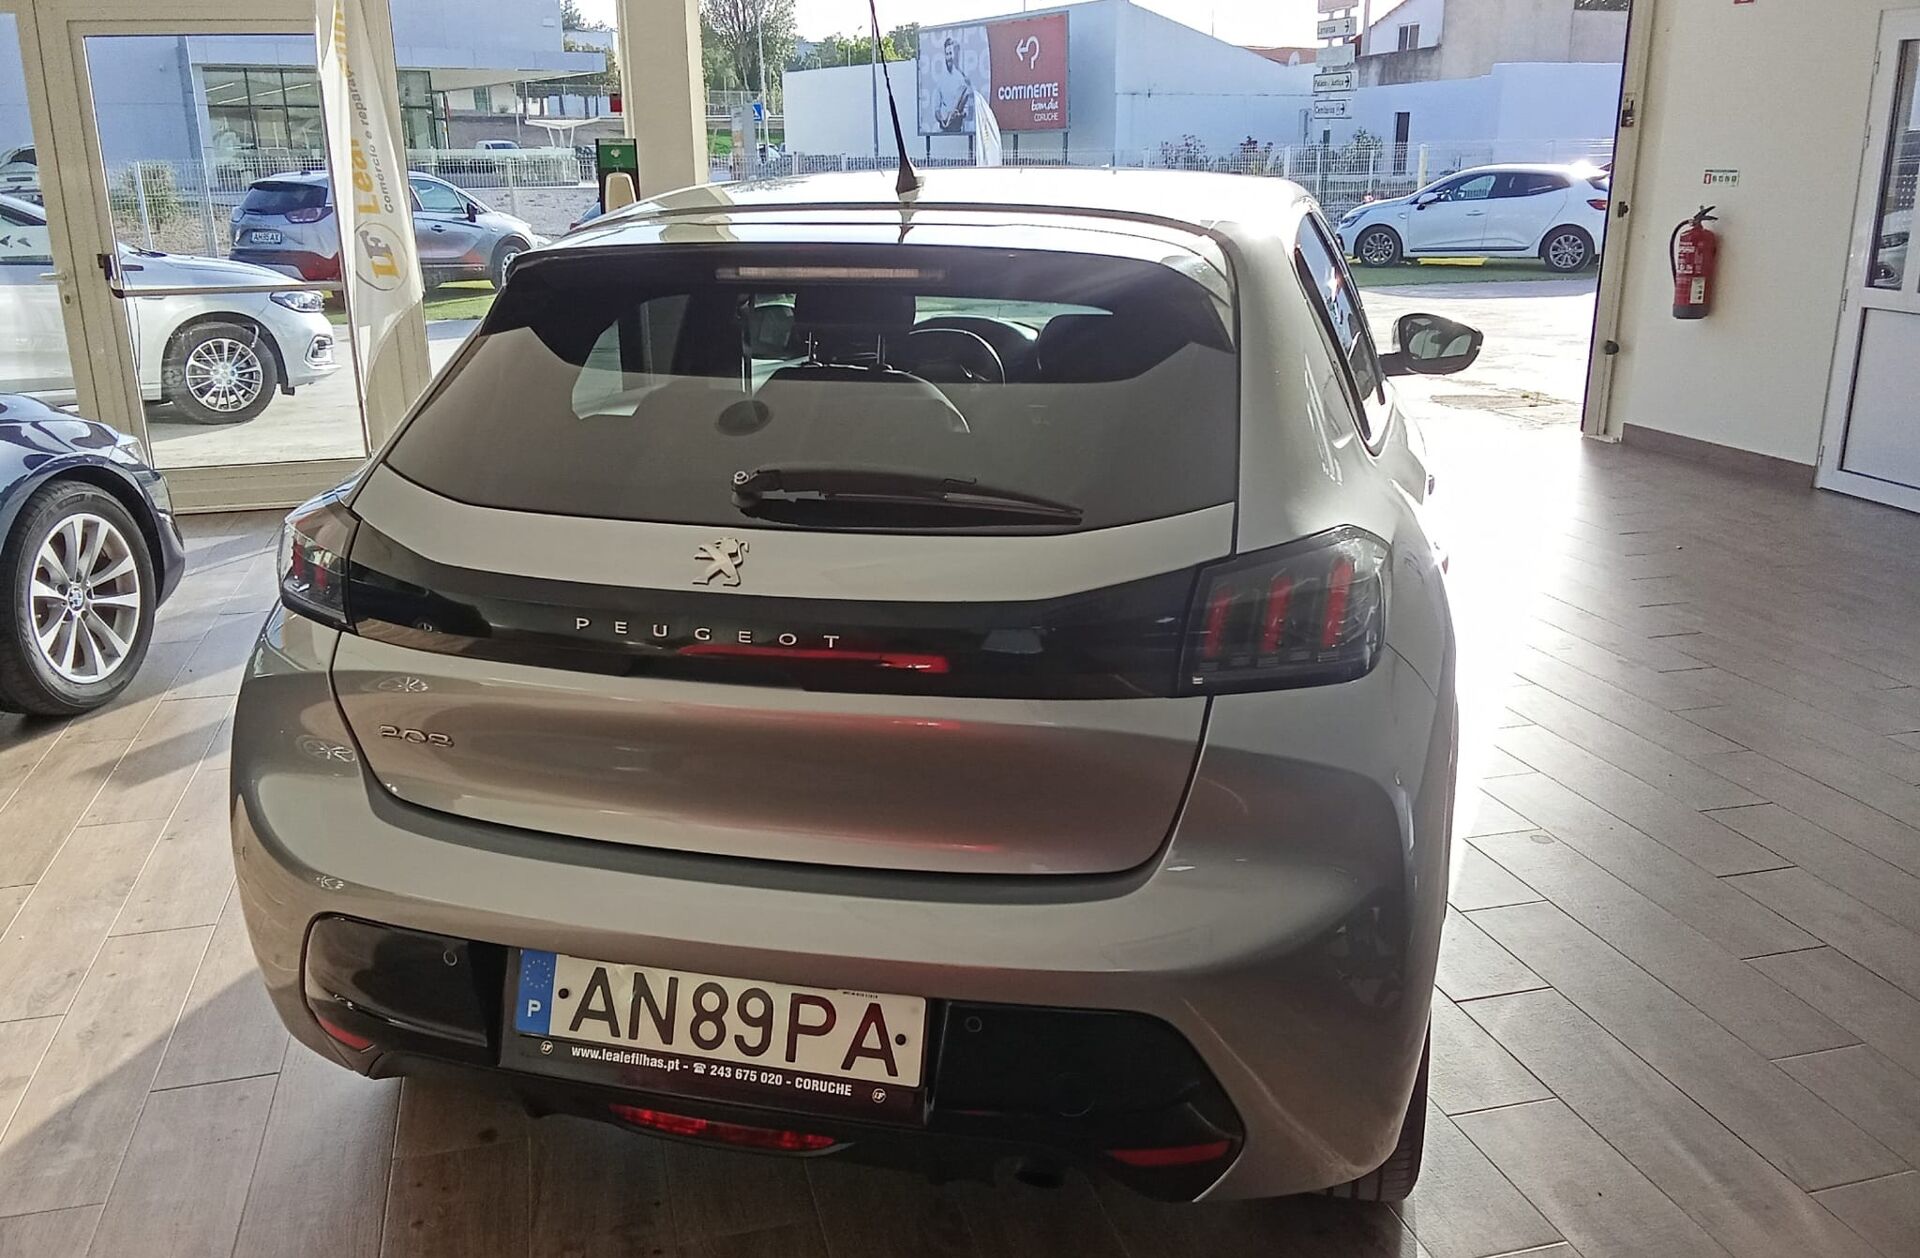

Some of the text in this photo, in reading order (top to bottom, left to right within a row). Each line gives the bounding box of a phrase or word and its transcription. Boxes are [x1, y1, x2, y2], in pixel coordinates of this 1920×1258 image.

[998, 82, 1059, 100] CONTINENTE
[576, 617, 839, 649] PEUGEOT
[380, 724, 455, 747] 208
[527, 999, 541, 1017] P
[569, 966, 898, 1077] AN89PA
[571, 1046, 680, 1072] www.lealefilhas.pt
[710, 1064, 732, 1079] 243
[735, 1068, 757, 1082] 675
[760, 1073, 783, 1086] 020
[795, 1076, 852, 1096] CORUCHE
